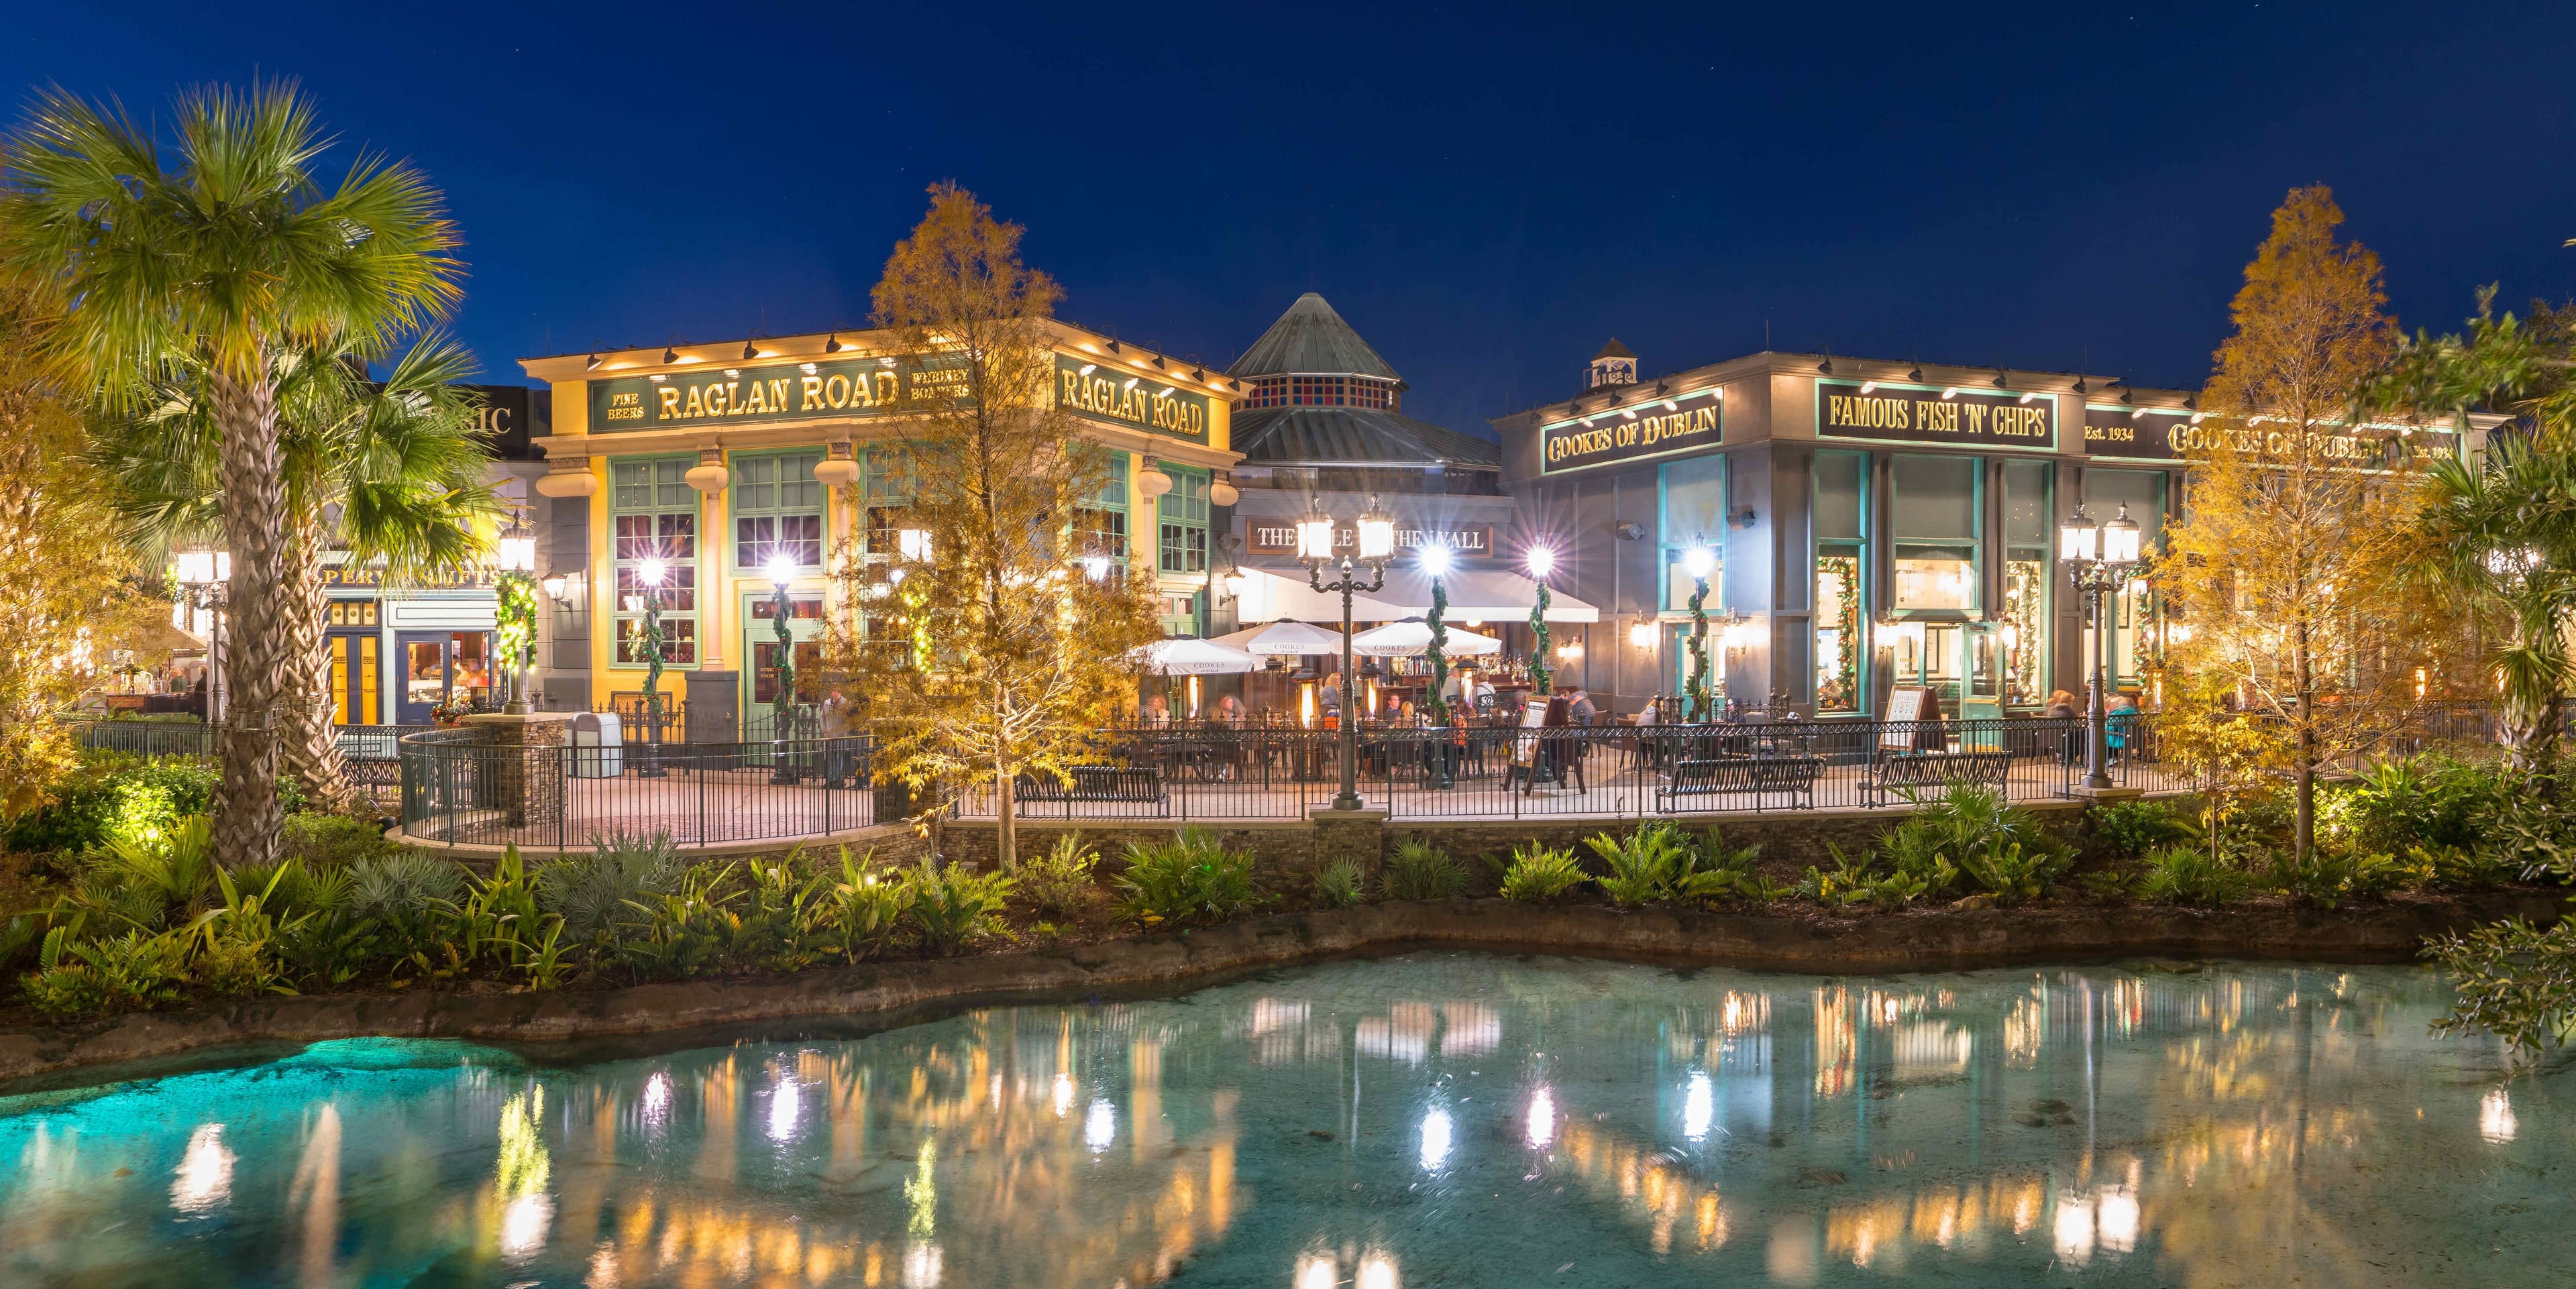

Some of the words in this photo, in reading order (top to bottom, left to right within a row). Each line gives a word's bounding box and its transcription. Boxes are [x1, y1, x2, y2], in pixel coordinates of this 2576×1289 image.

[607, 406, 645, 421] BEERS
[612, 393, 639, 406] FINE
[658, 378, 791, 420] RAGLAN
[801, 372, 900, 412] ROAD
[1062, 369, 1146, 424] RAGLAN
[1151, 394, 1203, 436] ROAD
[1547, 427, 1612, 462] COOKES
[1617, 421, 1639, 448] OF
[1642, 405, 1718, 446] DUBLIN
[1829, 395, 1909, 429] FAMOUS
[1915, 400, 1959, 433] FISH
[1992, 405, 2045, 438] CHIPS
[2084, 426, 2106, 441] Est.
[2108, 427, 2135, 442] 1934
[2167, 423, 2261, 453] COOKES
[2305, 431, 2384, 459] DUBL
[1257, 527, 1296, 546] THE
[1331, 529, 1353, 547] LE
